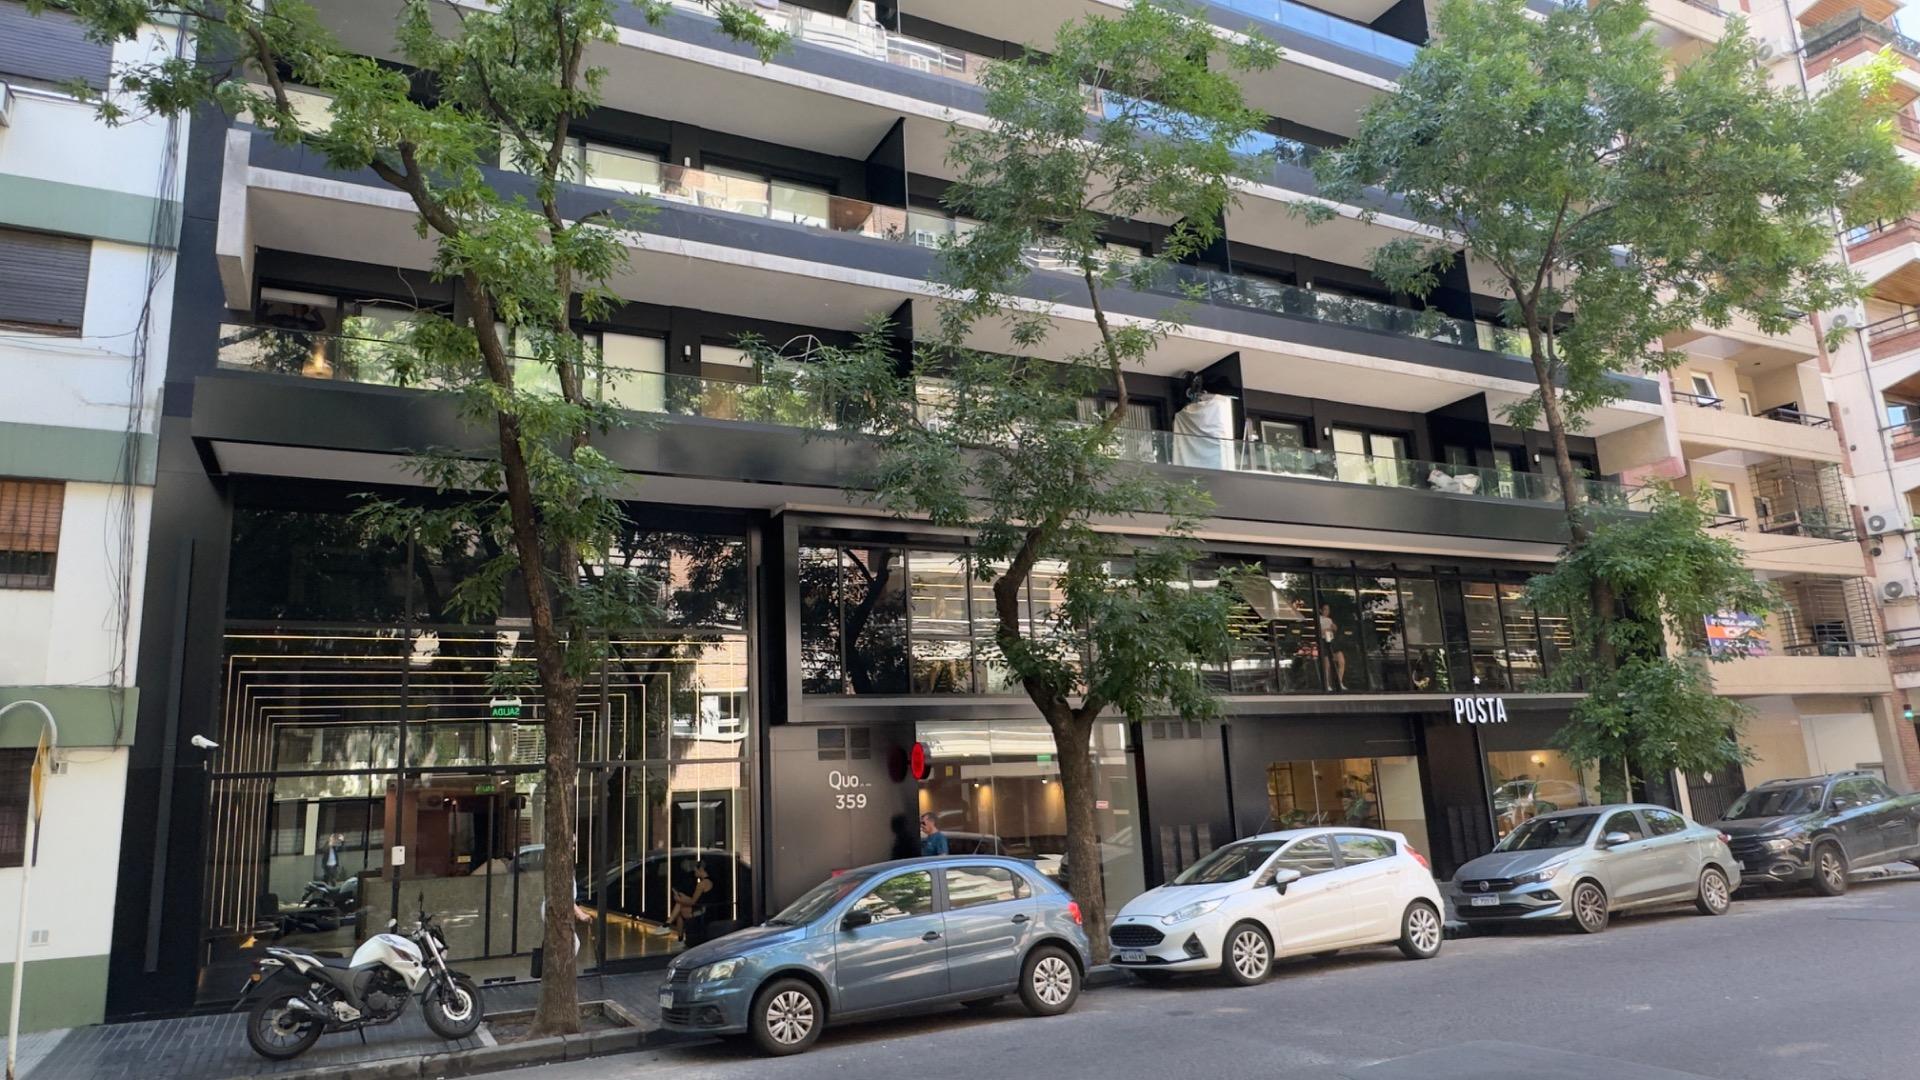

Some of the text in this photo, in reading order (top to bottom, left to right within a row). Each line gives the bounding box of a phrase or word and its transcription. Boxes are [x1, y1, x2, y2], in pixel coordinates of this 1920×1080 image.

[1454, 697, 1508, 723] POSTA
[829, 770, 859, 790] Quo
[835, 793, 867, 809] 359
